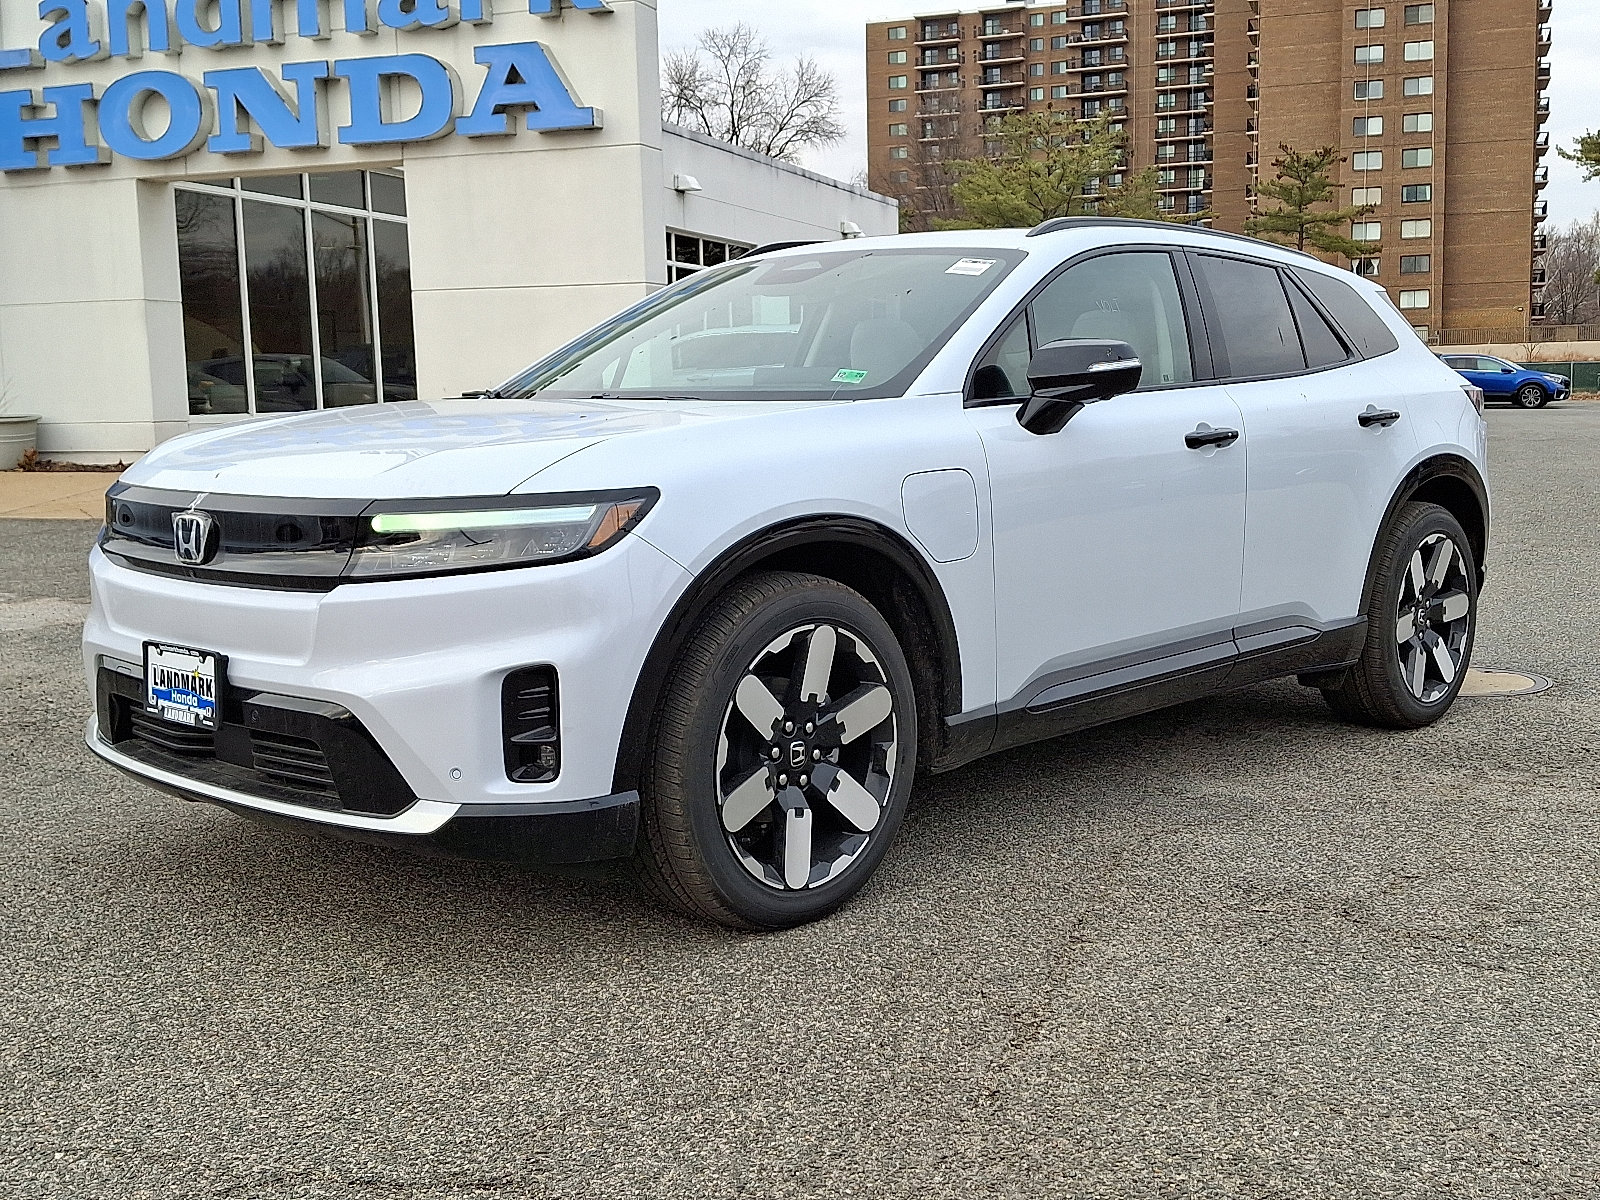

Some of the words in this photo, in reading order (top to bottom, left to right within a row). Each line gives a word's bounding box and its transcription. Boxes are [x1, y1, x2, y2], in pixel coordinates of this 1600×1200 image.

[0, 0, 608, 69] andm
[0, 41, 598, 171] HONDA
[153, 666, 213, 698] LANDMARK
[171, 689, 198, 706] Honda
